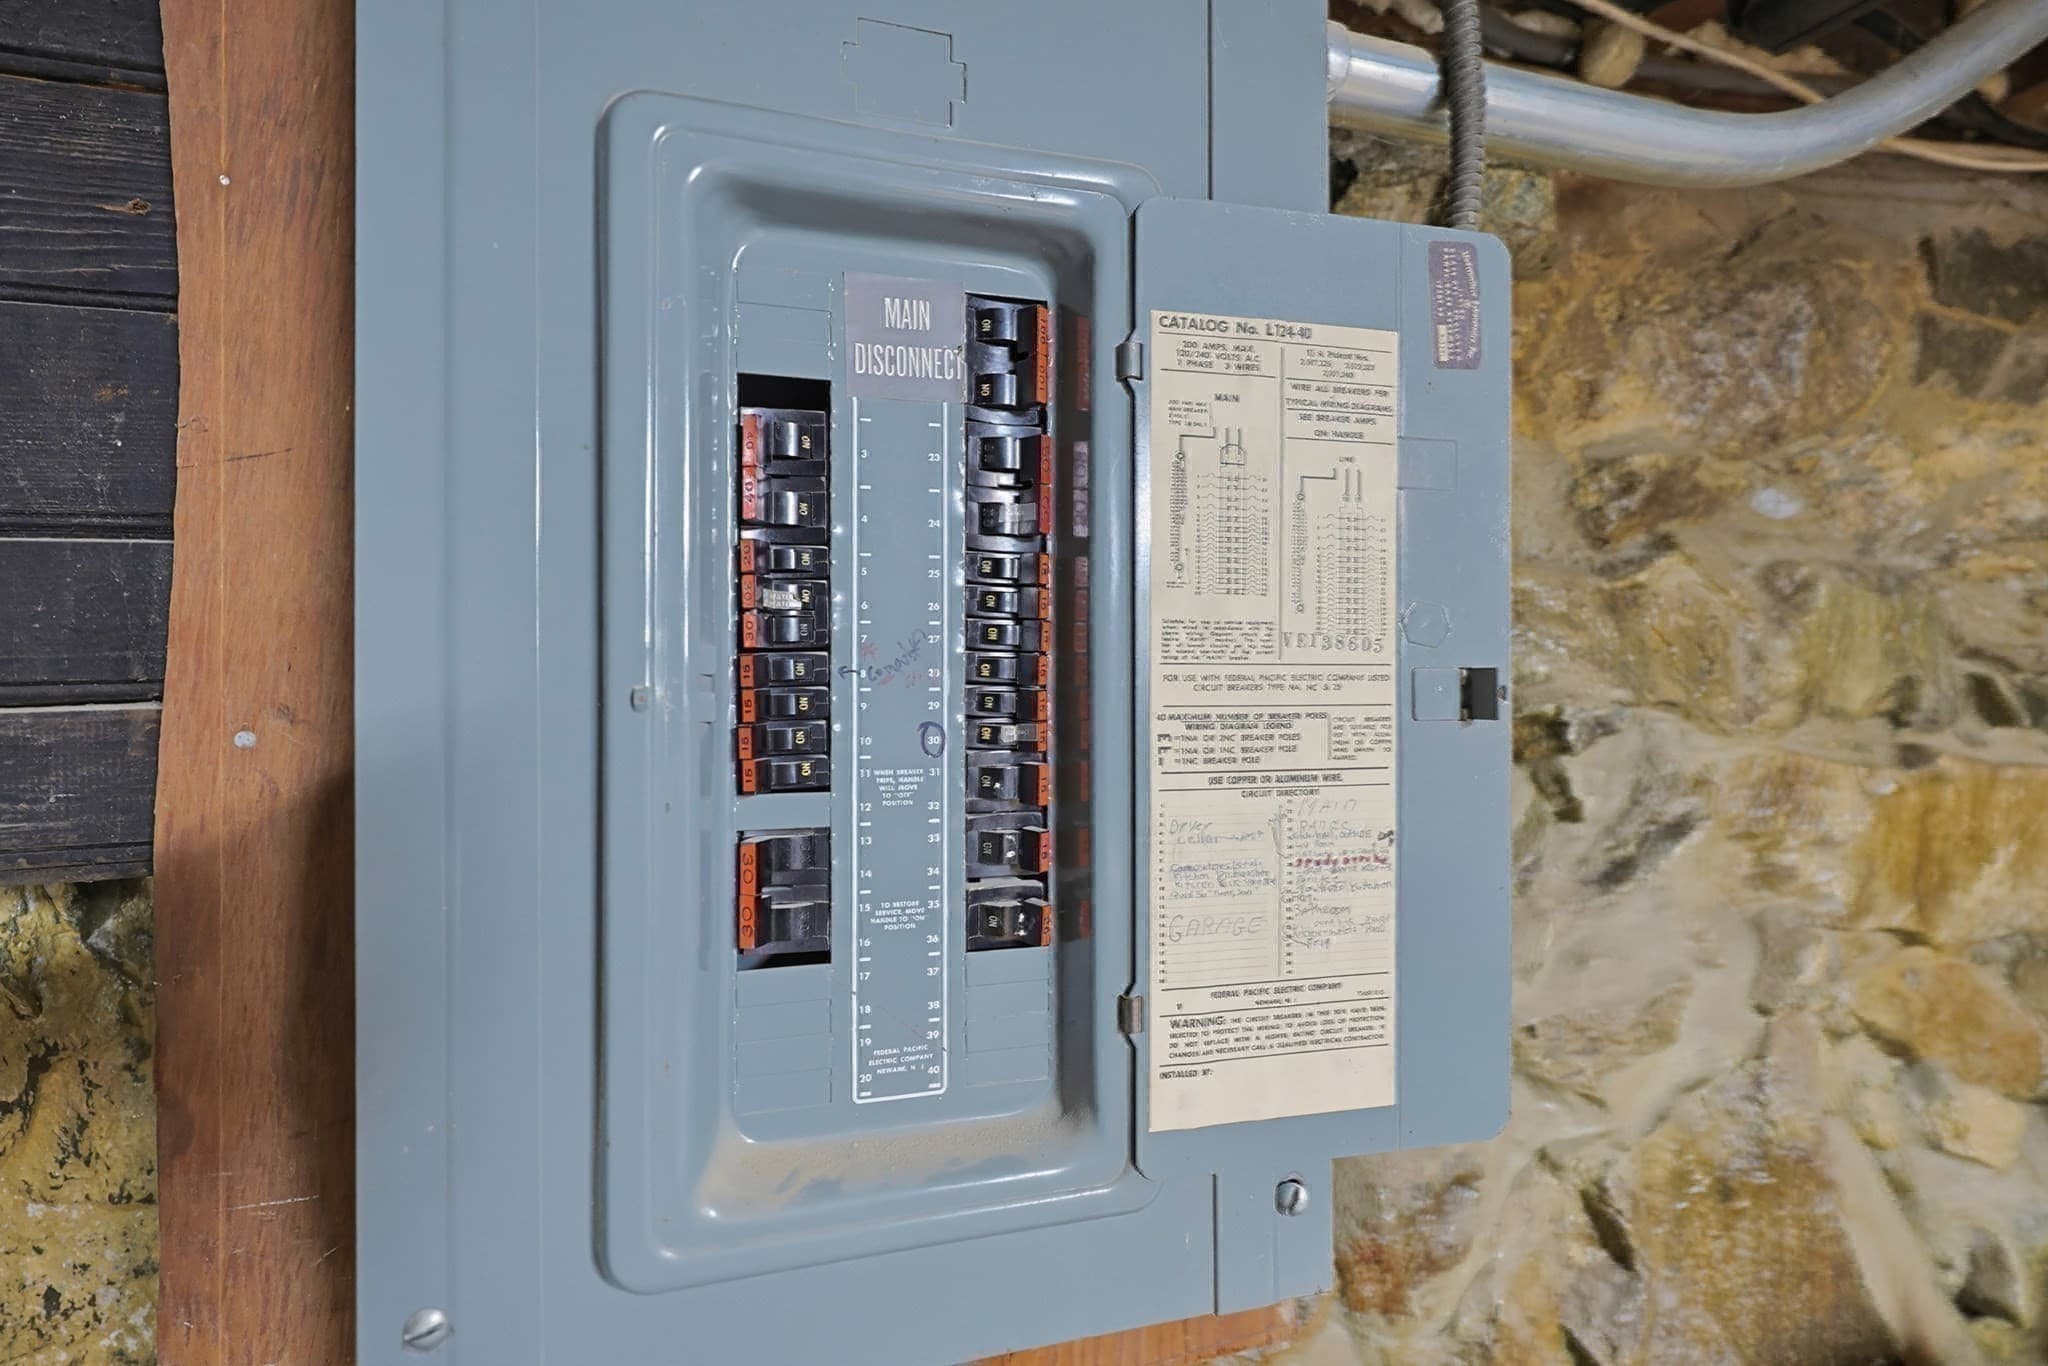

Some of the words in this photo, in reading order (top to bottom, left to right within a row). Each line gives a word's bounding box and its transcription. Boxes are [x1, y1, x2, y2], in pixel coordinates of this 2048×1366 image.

[884, 298, 930, 330] MAIN
[981, 319, 991, 332] ON
[1159, 316, 1229, 333] CATALOG
[1236, 322, 1259, 335] No.
[854, 342, 962, 380] DISCONNECT
[981, 384, 990, 396] ON
[1214, 393, 1240, 403] MAIN
[801, 435, 811, 449] ON
[861, 450, 868, 459] 3
[928, 453, 940, 462] 23
[799, 502, 808, 516] ON
[861, 515, 868, 523] 4
[928, 520, 940, 528] 24
[801, 552, 810, 566] ON
[981, 560, 992, 573] ON
[861, 568, 868, 576] 5
[928, 570, 940, 579] 25
[861, 602, 868, 610] 6
[985, 595, 995, 608] ON
[928, 602, 940, 611] 26
[745, 620, 754, 639] 30
[800, 623, 809, 636] ON
[987, 627, 998, 640] ON
[861, 635, 868, 643] 7
[928, 635, 940, 643] 27
[795, 662, 805, 676] ON
[860, 669, 866, 678] 8
[980, 663, 990, 677] ON
[1200, 674, 1220, 682] WITH
[1224, 674, 1255, 682] FEDERAL
[1193, 684, 1223, 692] CIRCUIT
[799, 697, 809, 710] ON
[861, 703, 867, 711] 9
[928, 702, 940, 711] 29
[984, 696, 994, 709] ON
[795, 731, 805, 744] ON
[981, 727, 992, 740] ON
[860, 737, 872, 745] 10
[928, 736, 940, 744] 30
[801, 762, 811, 776] ON
[860, 769, 870, 778] 11
[929, 768, 940, 776] 31
[981, 775, 991, 787] ON
[1226, 775, 1257, 785] COPPER
[1260, 775, 1271, 784] OR
[1241, 790, 1272, 798] CIRCUIT
[1276, 788, 1320, 797] DIRECTORY
[860, 803, 872, 811] 12
[860, 837, 872, 845] 13
[928, 834, 940, 842] 33
[983, 842, 993, 855] ON
[743, 853, 754, 884] 30
[928, 868, 940, 876] 34
[860, 870, 872, 878] 14
[859, 904, 870, 912] 15
[928, 900, 940, 909] 35
[742, 906, 753, 937] 30
[988, 915, 998, 928] ON
[859, 938, 870, 947] 16
[927, 935, 938, 943] 36
[859, 972, 870, 980] 17
[927, 968, 939, 976] 37
[859, 1005, 870, 1014] 18
[928, 1001, 940, 1009] 38
[927, 1031, 939, 1039] 39
[859, 1038, 871, 1046] 19
[873, 1048, 900, 1056] FEDERAL
[904, 1044, 928, 1052] PACIFIC
[868, 1058, 897, 1066] ELECTRIC
[900, 1054, 933, 1062] COMPANY
[928, 1066, 940, 1074] 40
[1159, 1069, 1198, 1079] INSTALLED
[860, 1074, 872, 1082] 20
